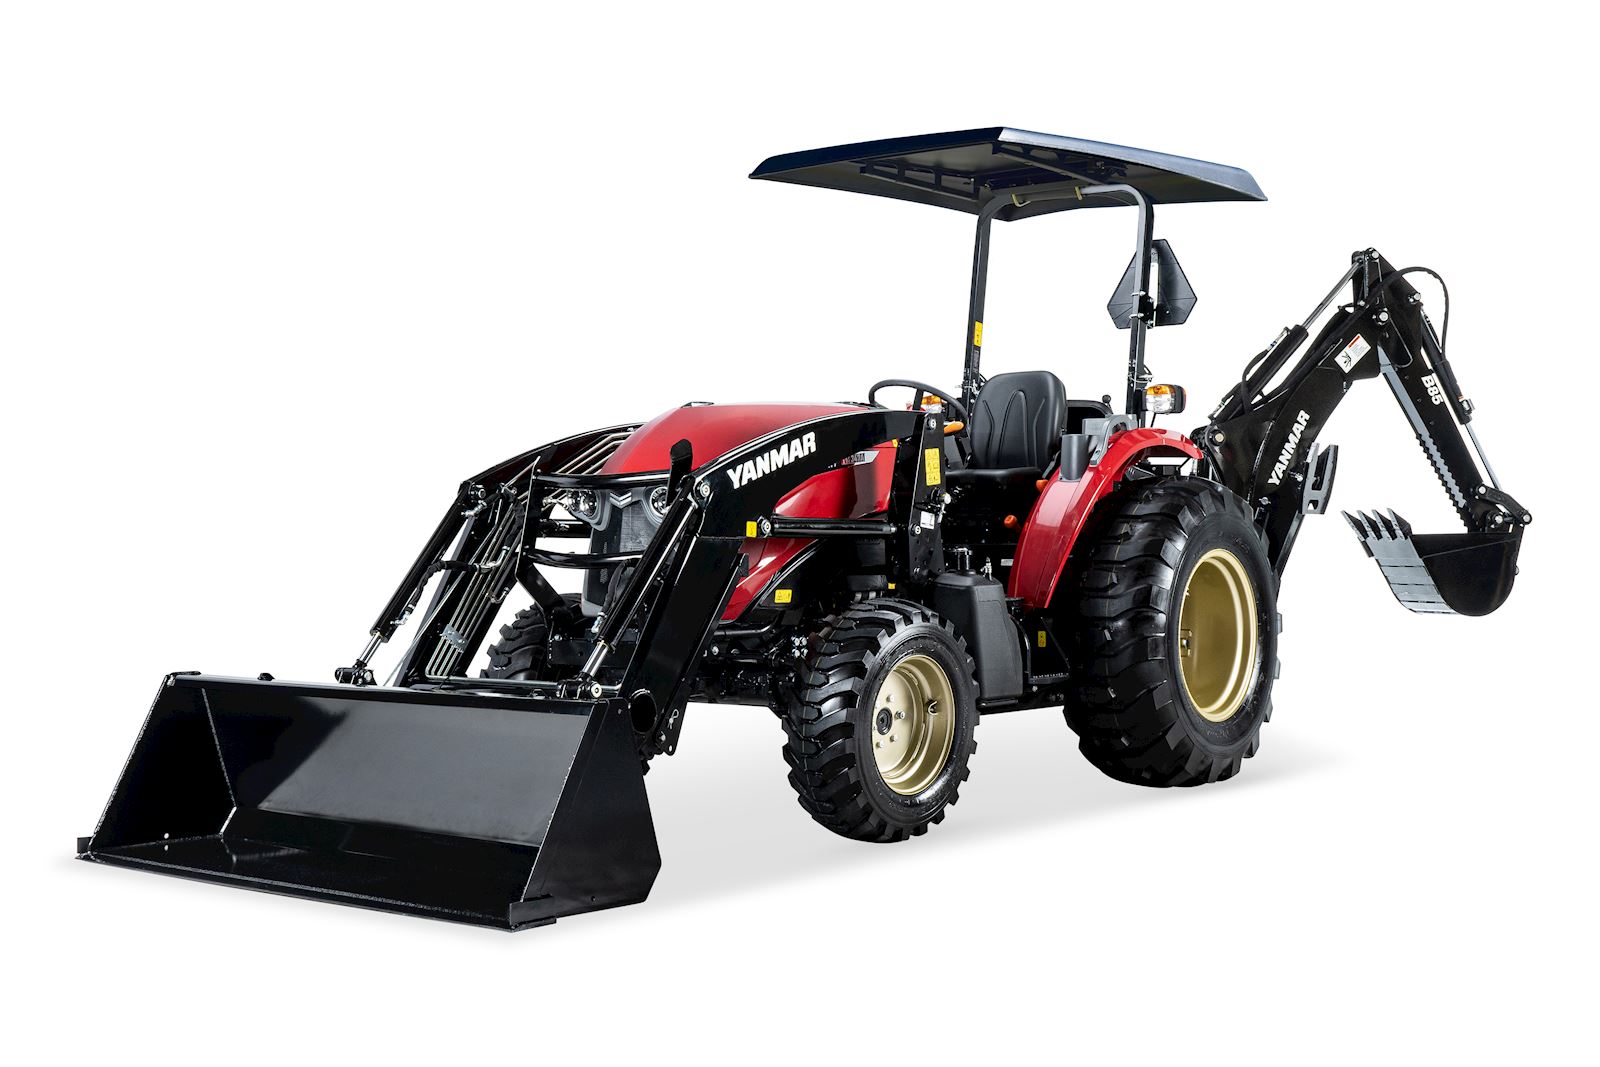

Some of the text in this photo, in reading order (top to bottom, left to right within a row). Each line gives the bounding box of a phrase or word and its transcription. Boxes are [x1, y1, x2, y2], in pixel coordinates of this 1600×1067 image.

[1421, 374, 1444, 405] B85
[726, 431, 817, 490] YANMAR
[1267, 409, 1310, 486] YANMAR
